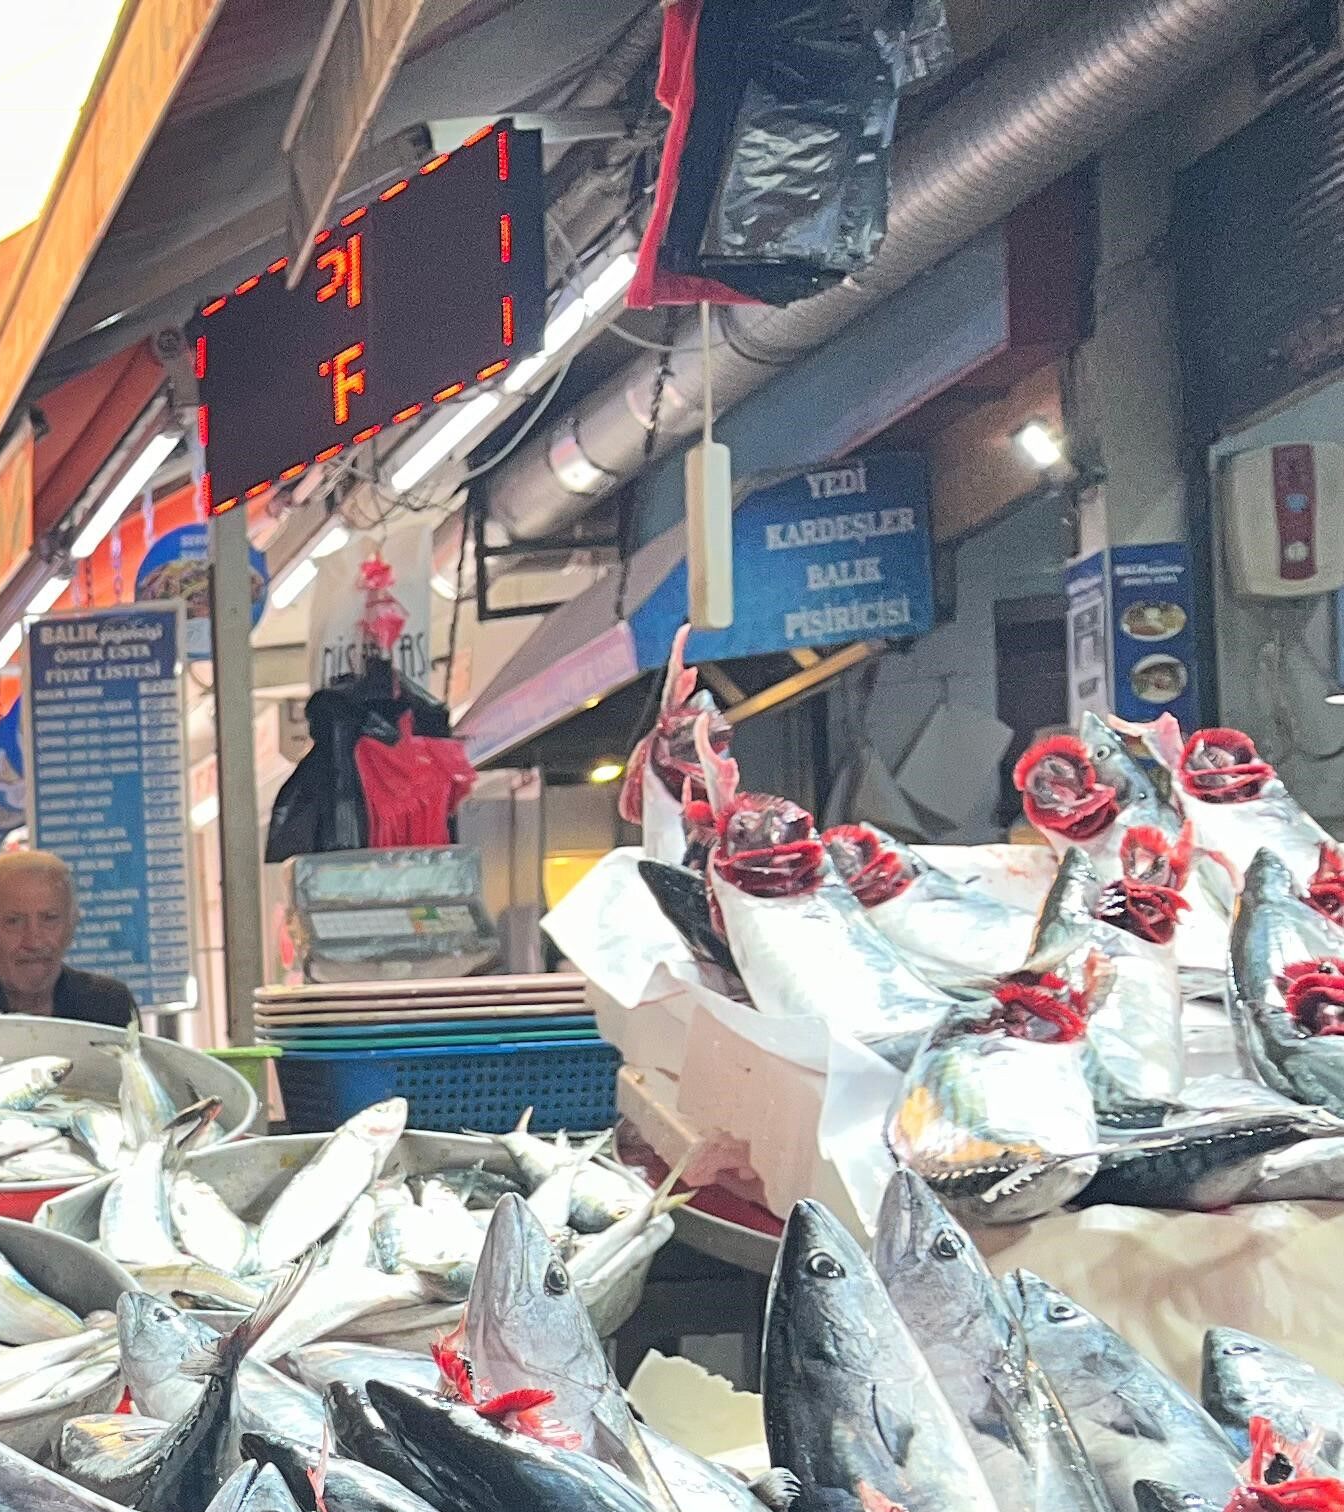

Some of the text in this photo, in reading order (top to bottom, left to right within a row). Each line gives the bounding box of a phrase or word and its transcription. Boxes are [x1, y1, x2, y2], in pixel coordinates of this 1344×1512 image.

[806, 467, 867, 498] YEDİ
[766, 507, 914, 549] KARDEŞLER
[806, 557, 882, 591] BALIK
